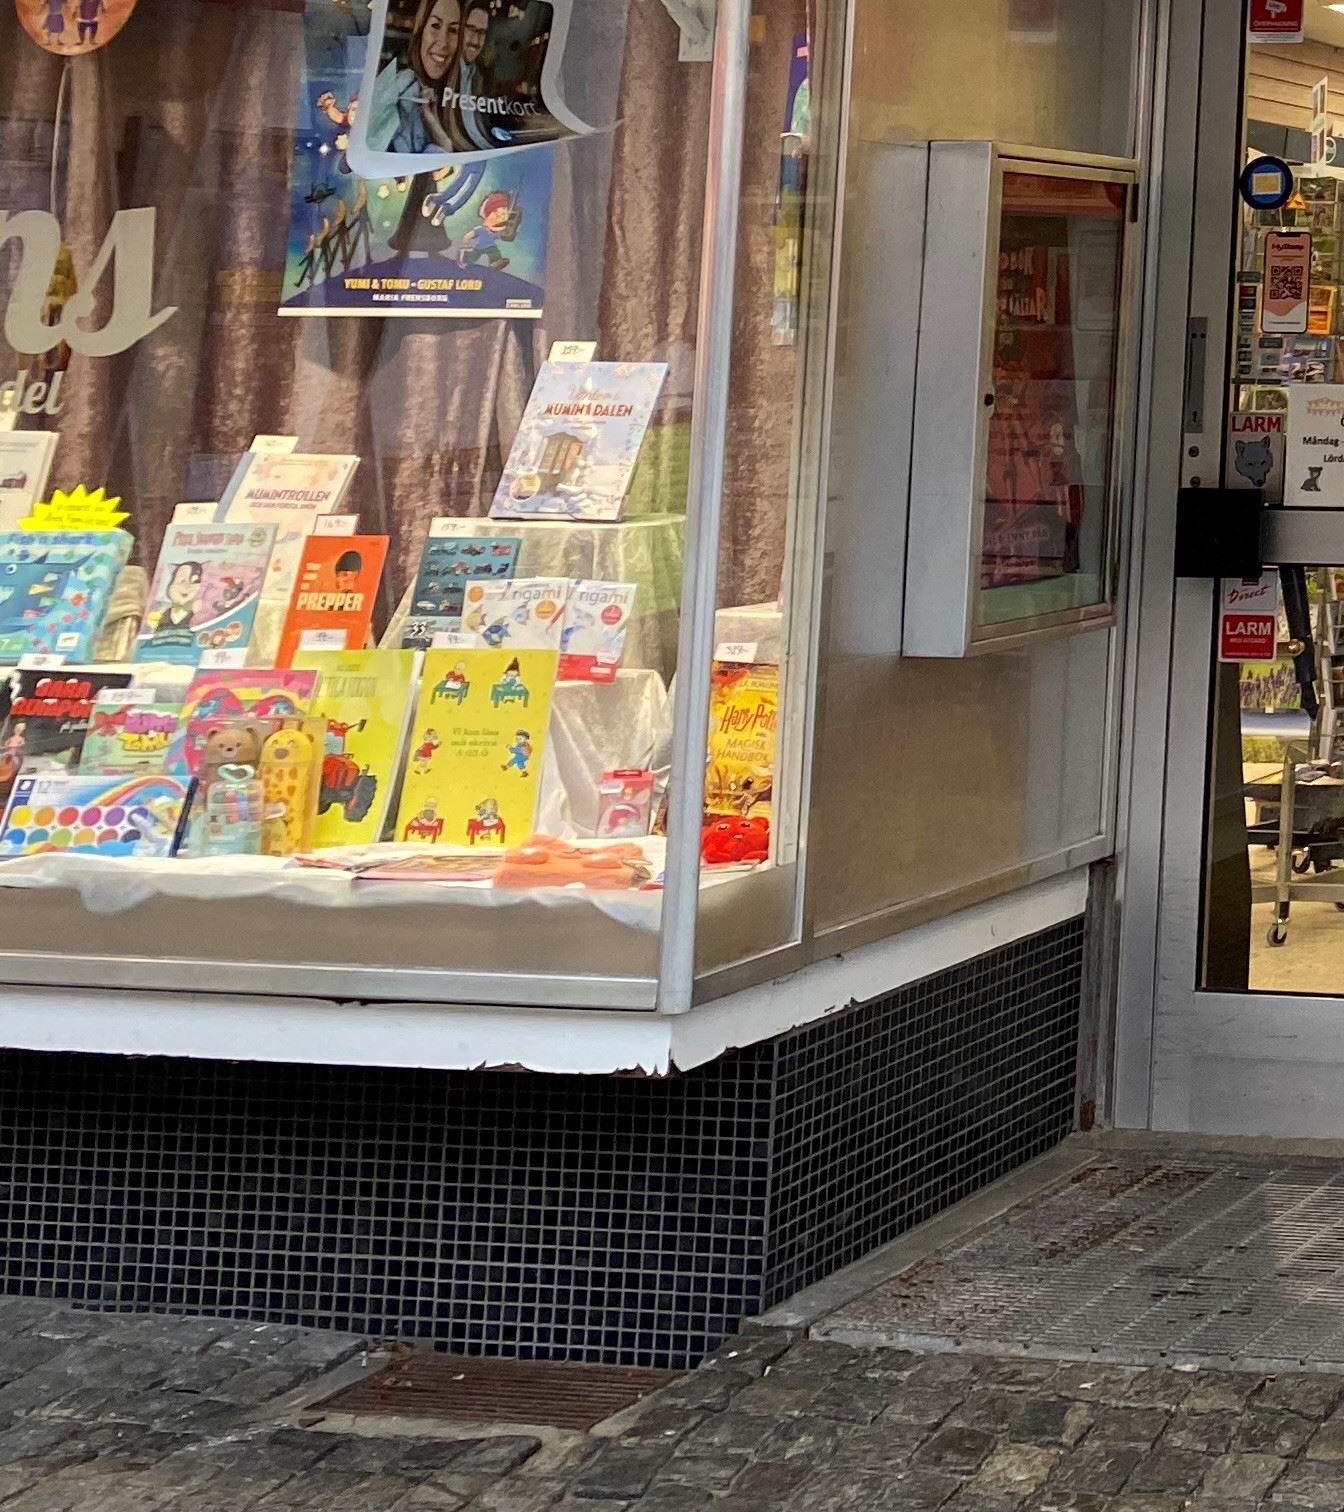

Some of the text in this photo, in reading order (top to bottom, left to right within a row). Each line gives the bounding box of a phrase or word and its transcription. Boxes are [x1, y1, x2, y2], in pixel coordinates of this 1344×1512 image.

[1231, 415, 1282, 433] LARM
[1302, 435, 1340, 448] Måndag
[296, 591, 365, 611] PREPPER
[1225, 621, 1271, 636] LARM
[725, 736, 767, 750] MAGISK
